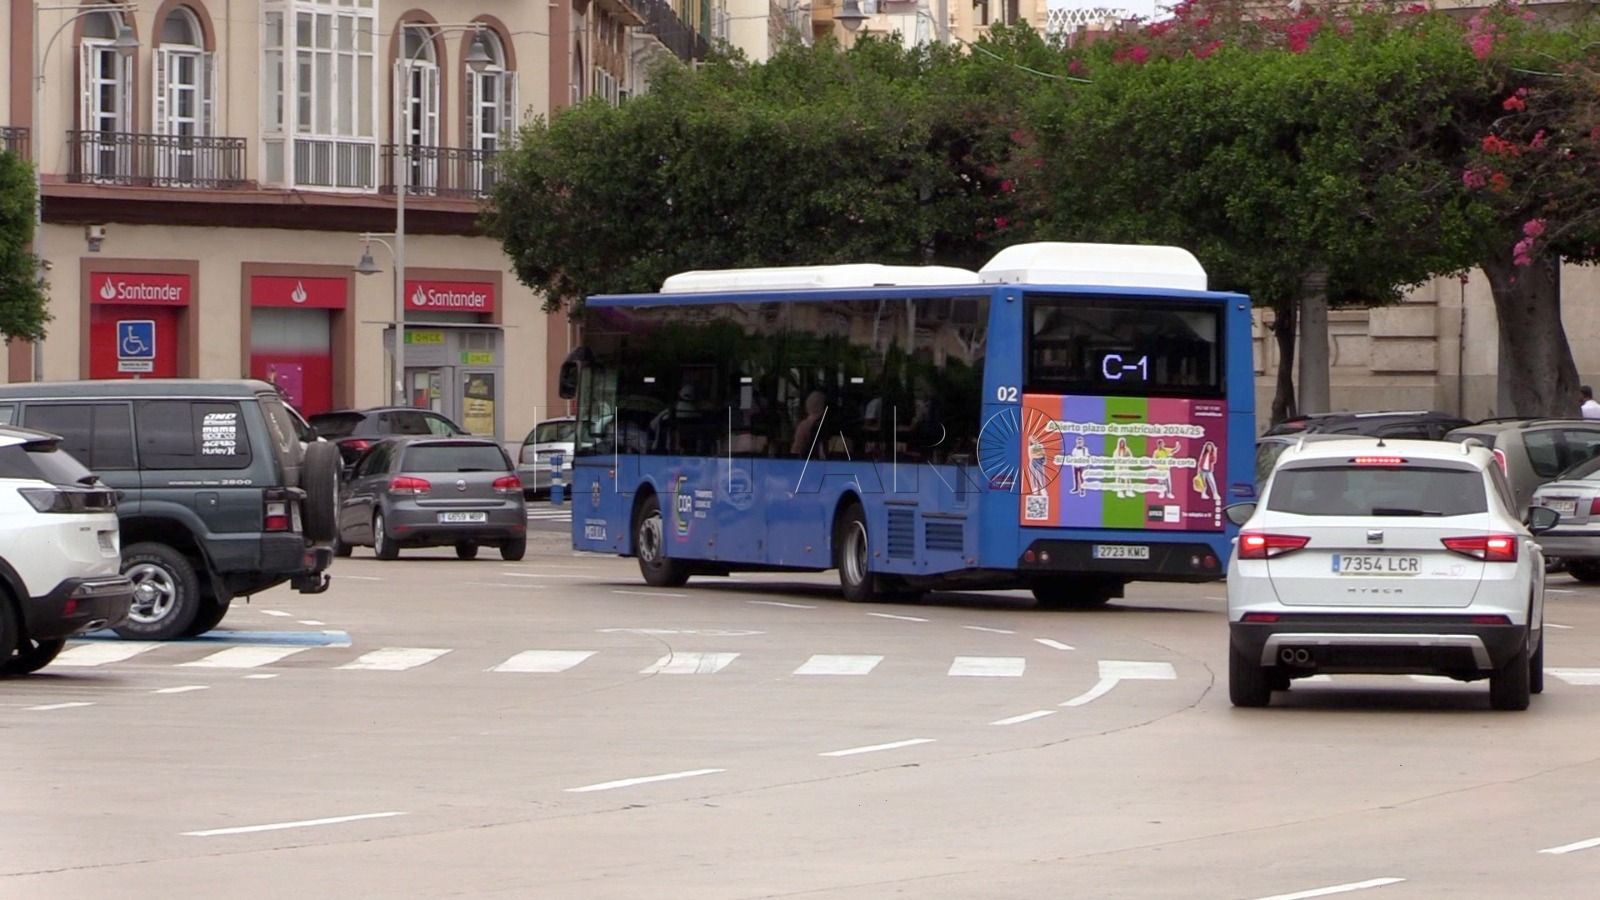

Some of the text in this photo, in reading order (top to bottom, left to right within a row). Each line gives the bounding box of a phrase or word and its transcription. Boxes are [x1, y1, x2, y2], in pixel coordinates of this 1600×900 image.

[117, 282, 182, 300] Santander
[427, 289, 487, 307] Santander
[414, 333, 441, 342] ONCE
[1102, 354, 1148, 381] C-1
[997, 386, 1018, 402] 02
[1083, 424, 1106, 434] plazo
[1108, 424, 1119, 432] de
[1163, 426, 1201, 435] 2024/25
[1101, 546, 1147, 557] 2723 KMC
[1343, 556, 1382, 571] 7354
[1388, 557, 1418, 572] LCR
